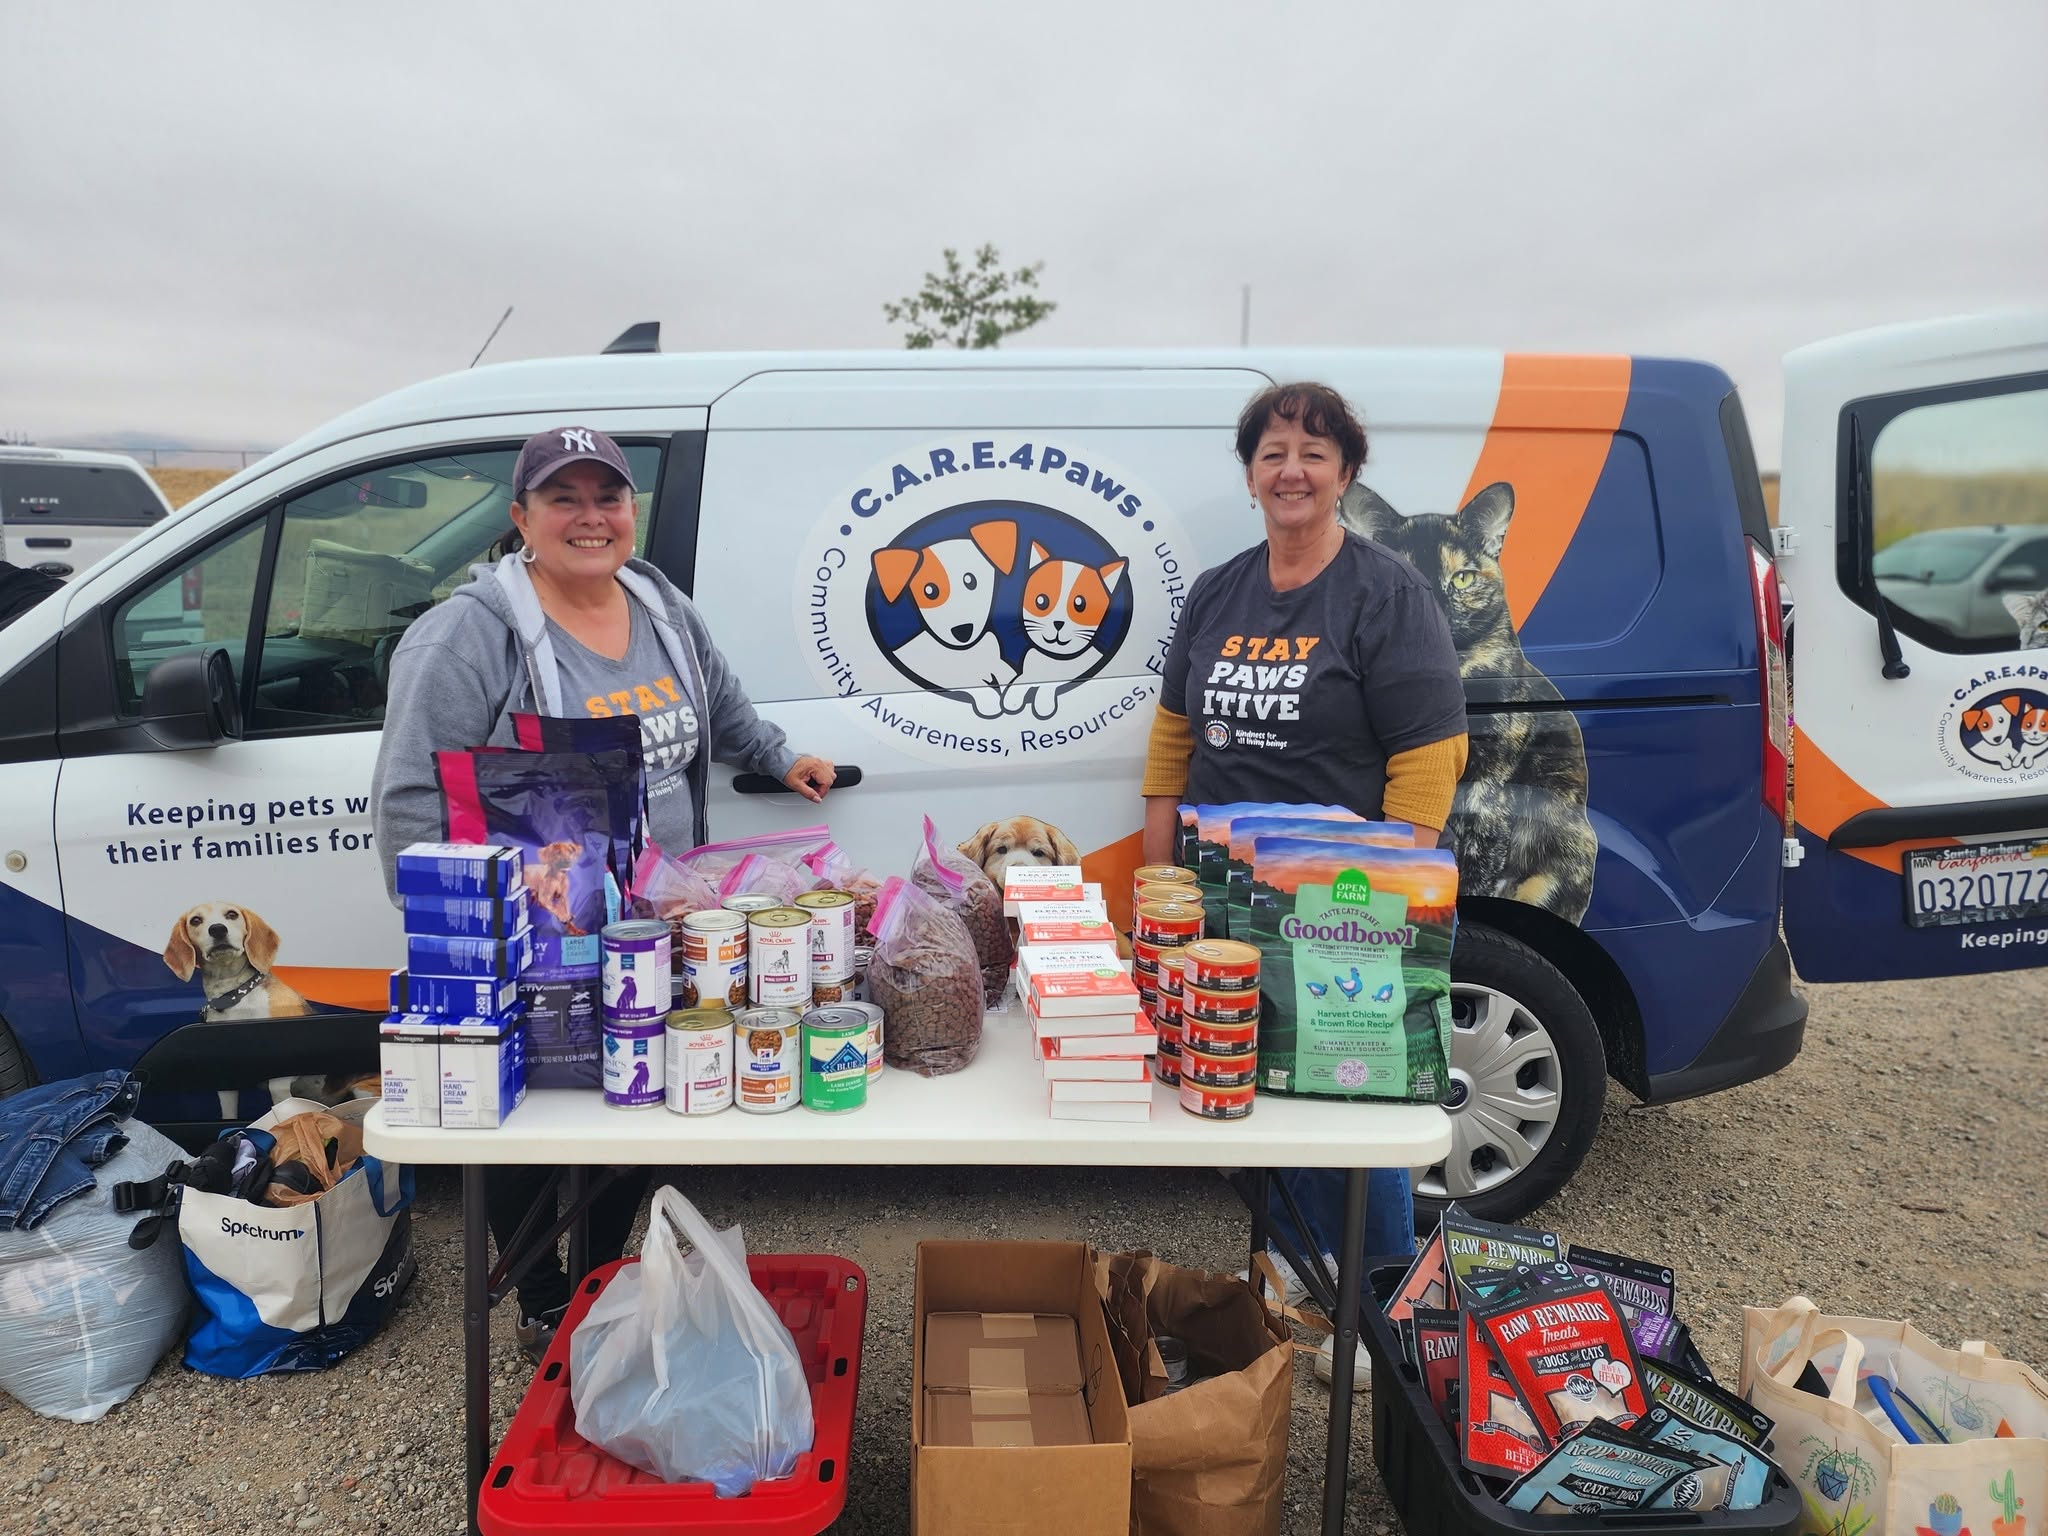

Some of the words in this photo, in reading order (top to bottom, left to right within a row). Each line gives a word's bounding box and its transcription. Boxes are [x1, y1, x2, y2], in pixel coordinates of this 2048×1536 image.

[560, 428, 597, 452] NY
[851, 441, 1142, 519] C.A.R.E.4Paws
[811, 547, 862, 698] Community
[862, 696, 1010, 757] Awareness,
[1020, 684, 1156, 752] Resources,
[1220, 635, 1320, 662] STAY
[1207, 661, 1309, 691] PAWS
[1954, 665, 2048, 701] C.A.R.E.4Pa
[585, 676, 681, 719] STAY
[1202, 690, 1300, 721] ITIVE
[1235, 730, 1266, 740] Kindness
[1266, 732, 1277, 740] for
[1246, 737, 1265, 750] living
[1266, 739, 1288, 750] beings
[1938, 711, 1958, 767] Community
[128, 798, 256, 829] Keeping
[269, 795, 335, 824] pets
[107, 839, 182, 864] their
[192, 832, 319, 860] families
[328, 828, 374, 852] for
[1914, 858, 1933, 868] MAY
[1336, 882, 1367, 894] OPEN
[1336, 892, 1367, 902] FARM
[1320, 907, 1341, 922] TASTE
[1342, 908, 1360, 916] CATS
[1360, 912, 1380, 928] CRAVE
[1284, 917, 1414, 947] Goodbowl
[1961, 928, 2048, 949] Keeping
[1310, 1018, 1316, 1026] &
[1318, 1018, 1345, 1027] Brown
[1346, 1020, 1366, 1028] Rice
[1367, 1020, 1394, 1030] Recipe
[1317, 1010, 1350, 1018] Harvest
[1352, 1010, 1388, 1019] Chicken
[393, 1036, 424, 1044] Neutrogena
[454, 1036, 484, 1045] Neutrogena
[836, 1060, 858, 1072] BLUE
[221, 1216, 298, 1242] Spectrum
[1452, 1238, 1480, 1256] RAW
[1604, 1274, 1666, 1316] REWARDS
[1499, 1314, 1531, 1344] RAW
[1532, 1302, 1610, 1328] REWARDS
[1540, 1324, 1580, 1346] Treats
[1424, 1336, 1459, 1362] RAW
[1543, 1352, 1570, 1368] DOGS
[1581, 1345, 1604, 1361] CATS
[1598, 1370, 1626, 1386] HEART
[1602, 1364, 1615, 1373] HAVE
[1569, 1380, 1591, 1395] NWN
[1505, 1448, 1534, 1465] BEEF
[1570, 1457, 1620, 1480] Premium
[1582, 1480, 1609, 1497] CATS
[1618, 1488, 1640, 1502] DOGS
